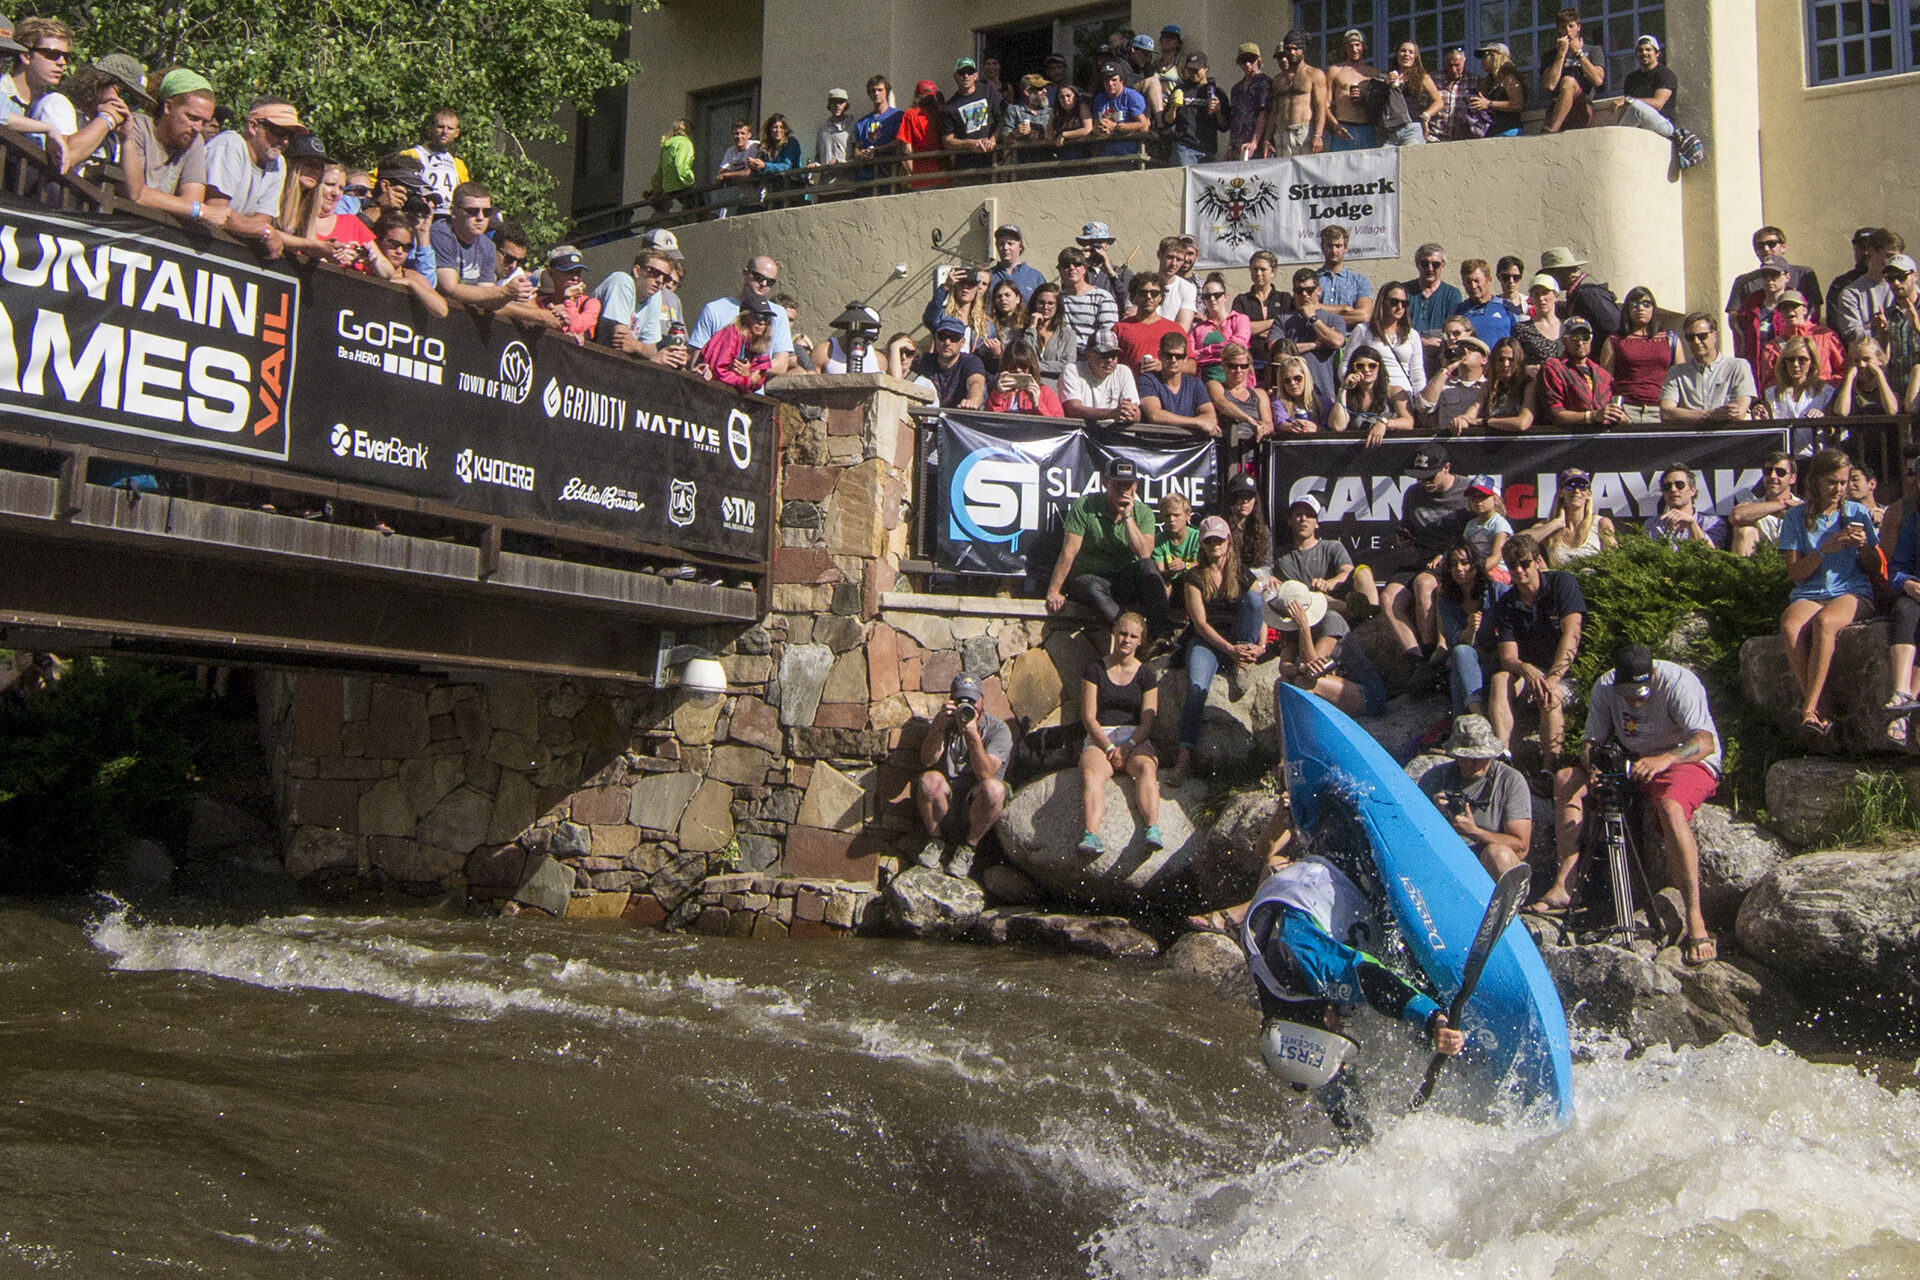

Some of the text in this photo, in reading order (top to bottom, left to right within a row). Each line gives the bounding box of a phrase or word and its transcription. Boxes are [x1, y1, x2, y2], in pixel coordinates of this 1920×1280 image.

[1288, 178, 1395, 201] Sitzmark
[1309, 202, 1373, 221] Lodge
[1355, 225, 1386, 236] Village
[0, 225, 258, 337] UNTAIN
[337, 309, 446, 361] GoPro
[338, 346, 348, 359] Be
[348, 351, 354, 360] a
[254, 293, 289, 436] VAIL
[458, 372, 519, 404] TOWN OF VAIL
[563, 384, 626, 431] GRINDTV
[635, 409, 720, 447] NATIVE
[353, 429, 428, 471] EverBank
[473, 455, 535, 491] KYOCERA
[1046, 467, 1205, 507] SLALINE
[558, 477, 645, 512] Eddie Bauer
[731, 497, 756, 527] TV8
[1397, 873, 1446, 952] Dagger
[1277, 1043, 1324, 1068] FIRST
